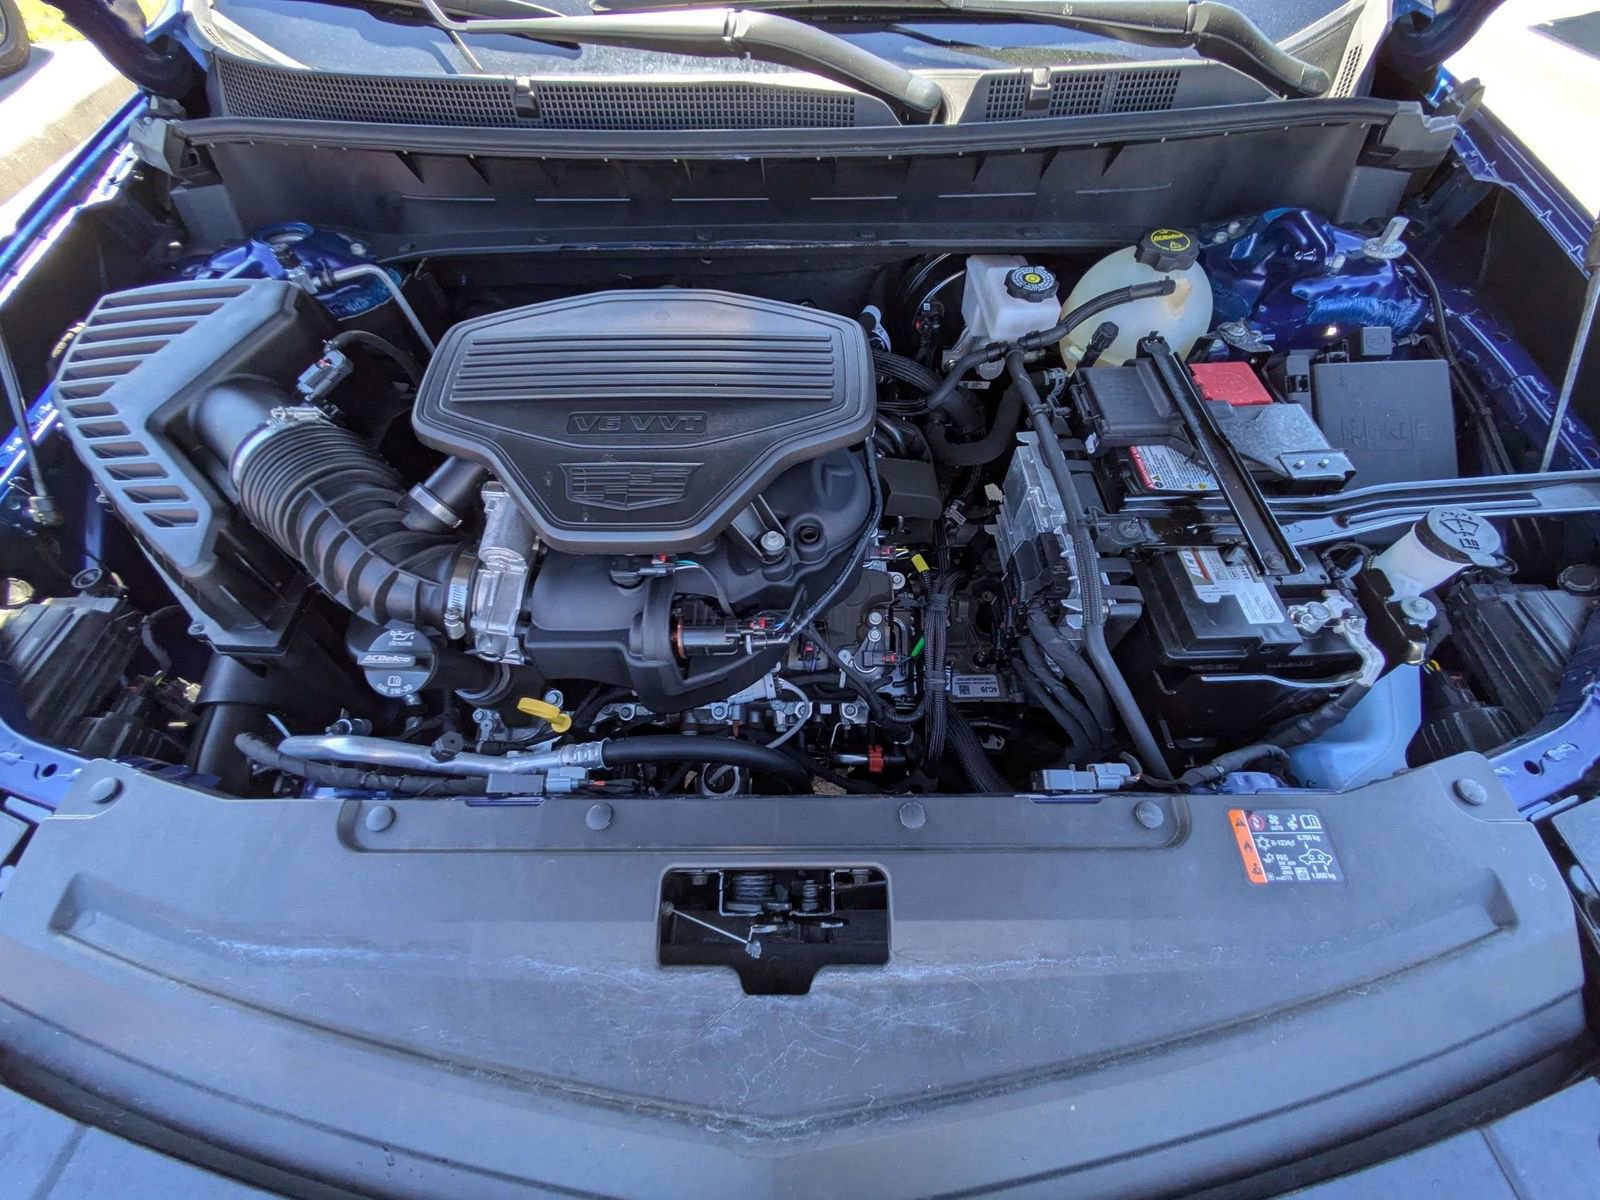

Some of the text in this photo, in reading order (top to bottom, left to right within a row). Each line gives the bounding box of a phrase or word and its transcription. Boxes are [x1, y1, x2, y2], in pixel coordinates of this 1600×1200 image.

[574, 415, 702, 431] V6 VVT
[363, 655, 411, 663] ACDelco
